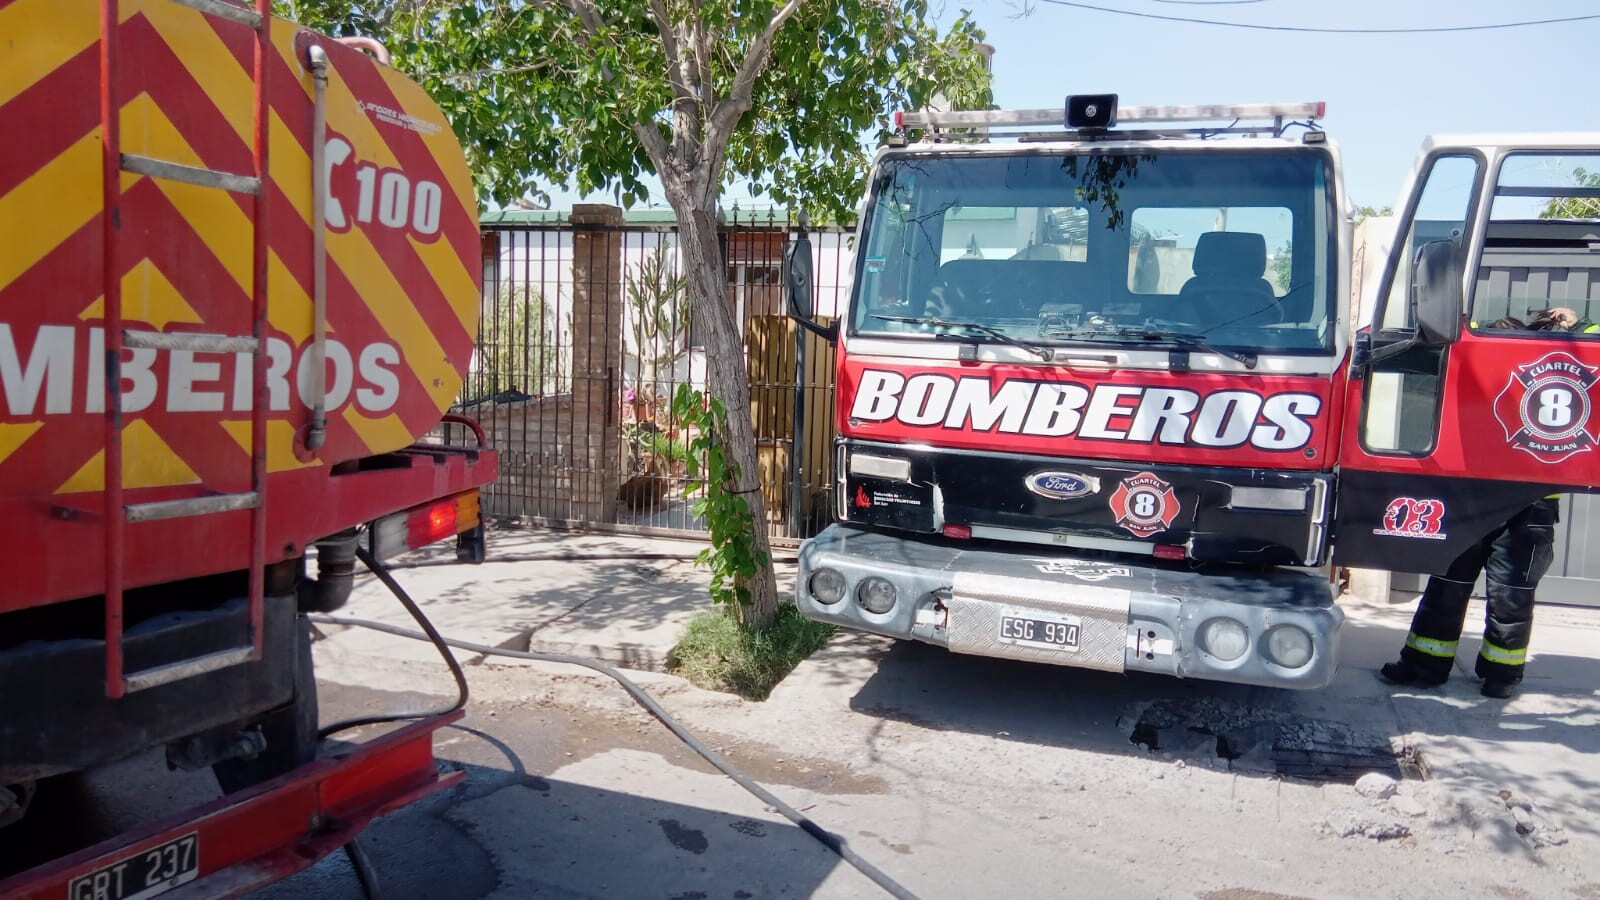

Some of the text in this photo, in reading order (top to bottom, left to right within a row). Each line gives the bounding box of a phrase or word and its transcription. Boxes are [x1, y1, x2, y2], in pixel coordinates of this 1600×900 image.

[356, 166, 442, 234] 100
[1530, 362, 1581, 377] CUARTEL
[852, 370, 1322, 450] BOMBEROS
[1538, 388, 1572, 426] 8
[1528, 441, 1577, 451] SAN JUAN
[1046, 476, 1077, 492] Ford
[1130, 478, 1161, 487] CUARTEL
[1134, 493, 1155, 516] 8
[1001, 616, 1078, 647] ESG 934
[75, 838, 194, 900] GRT 237
